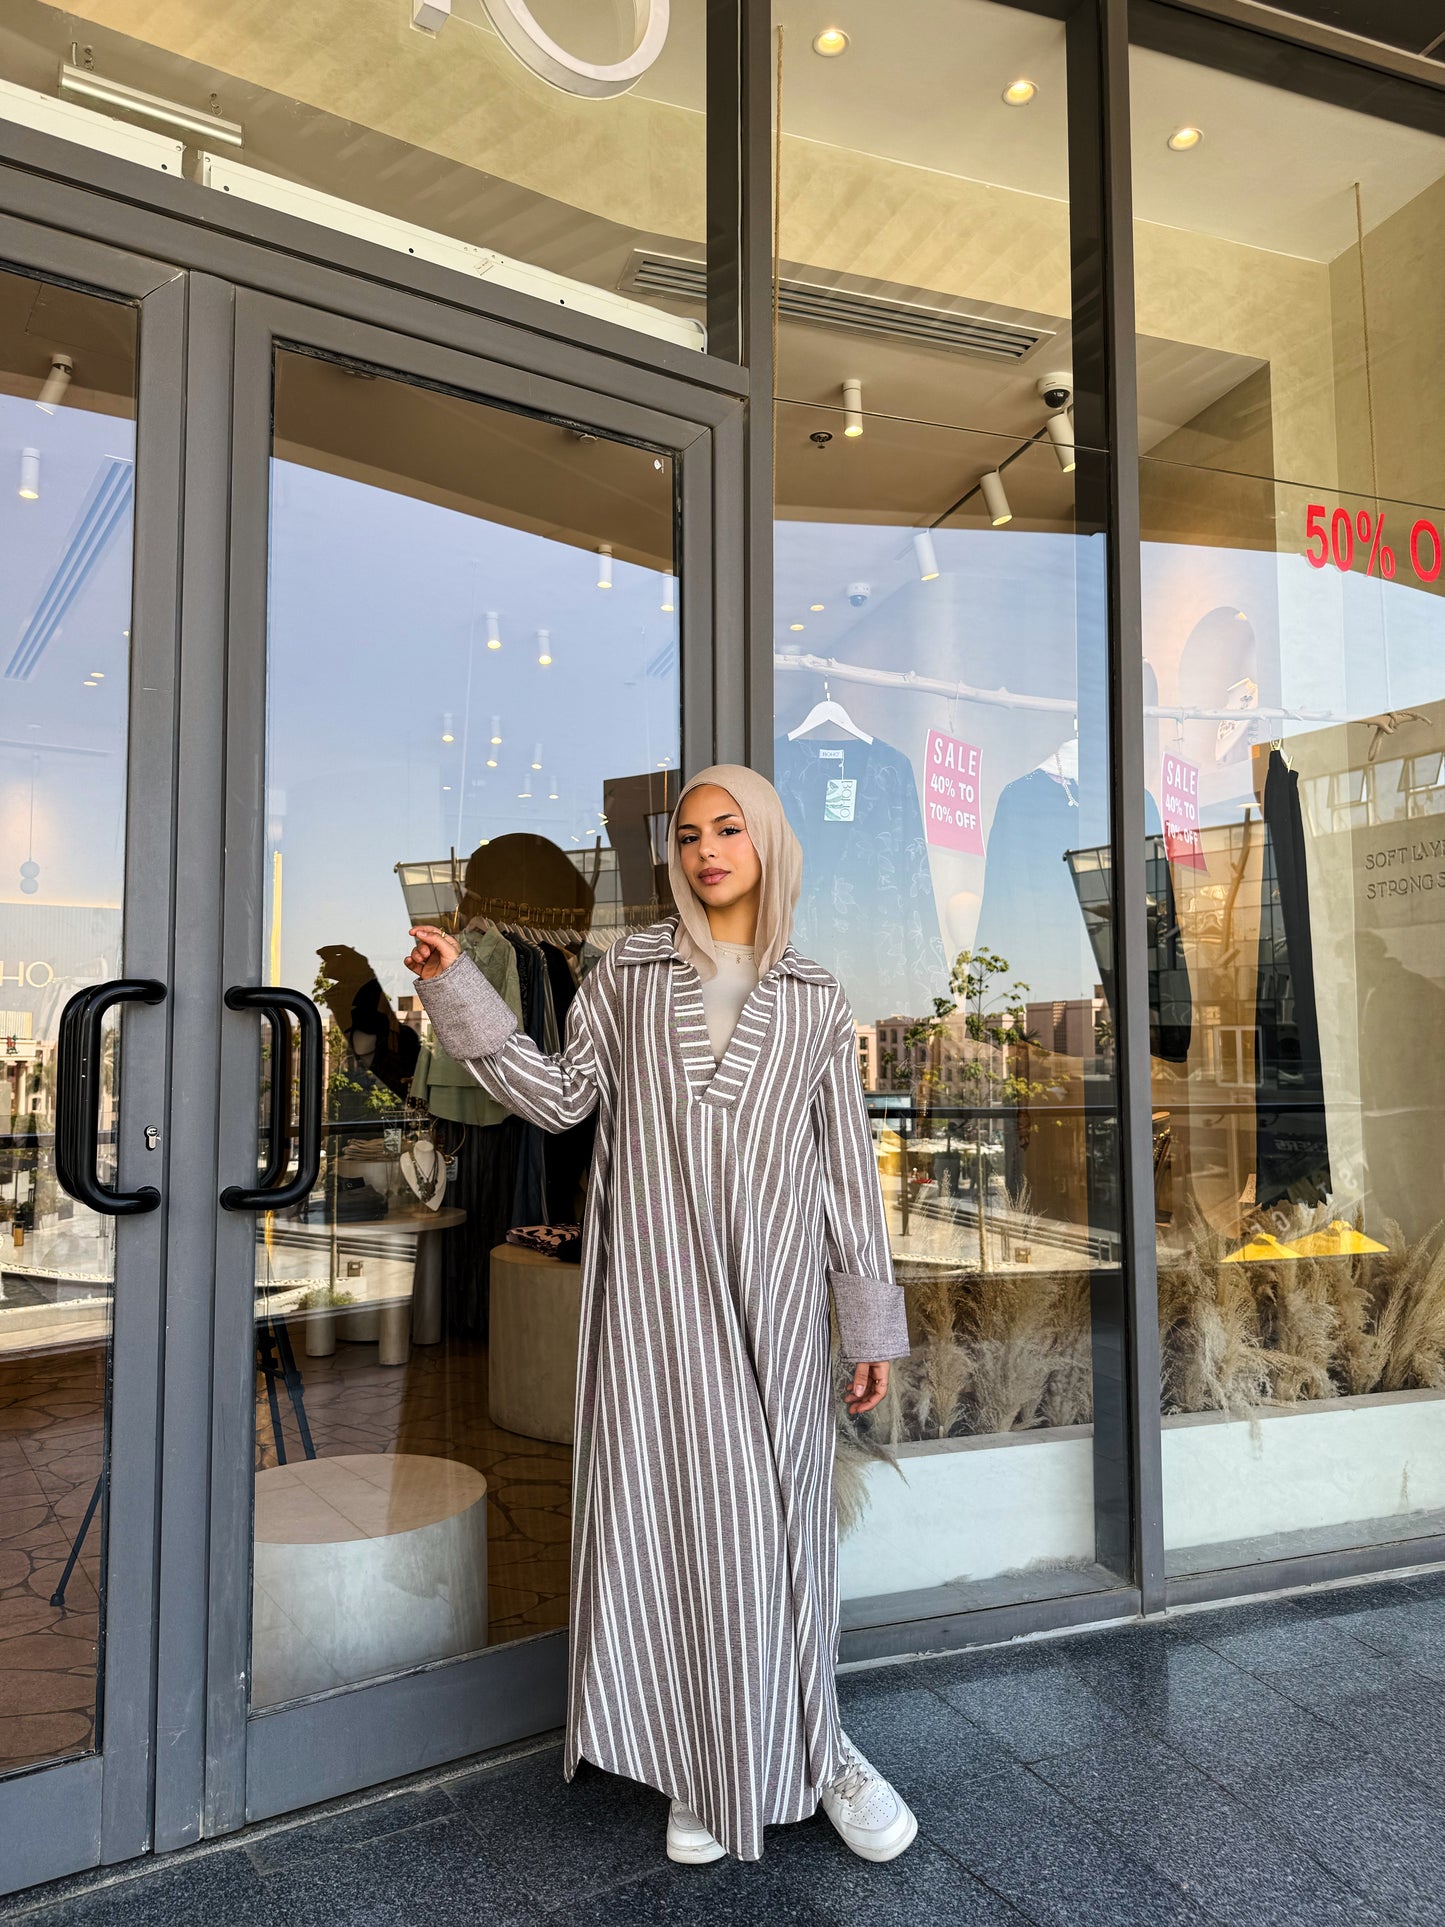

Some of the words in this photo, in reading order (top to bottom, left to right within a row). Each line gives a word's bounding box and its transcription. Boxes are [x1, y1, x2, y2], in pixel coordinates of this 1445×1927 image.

[1305, 503, 1396, 580] 50%
[933, 737, 978, 777] SALE
[930, 772, 956, 798] 40%
[958, 781, 975, 803] TO
[1166, 760, 1197, 796] SALE
[929, 801, 953, 825] 70%
[955, 809, 976, 831] OFF
[1165, 793, 1183, 816] 40%
[1183, 801, 1196, 821] TO
[1183, 827, 1199, 848] OFF
[1365, 847, 1408, 870] SOFT
[1366, 874, 1434, 900] STRONG
